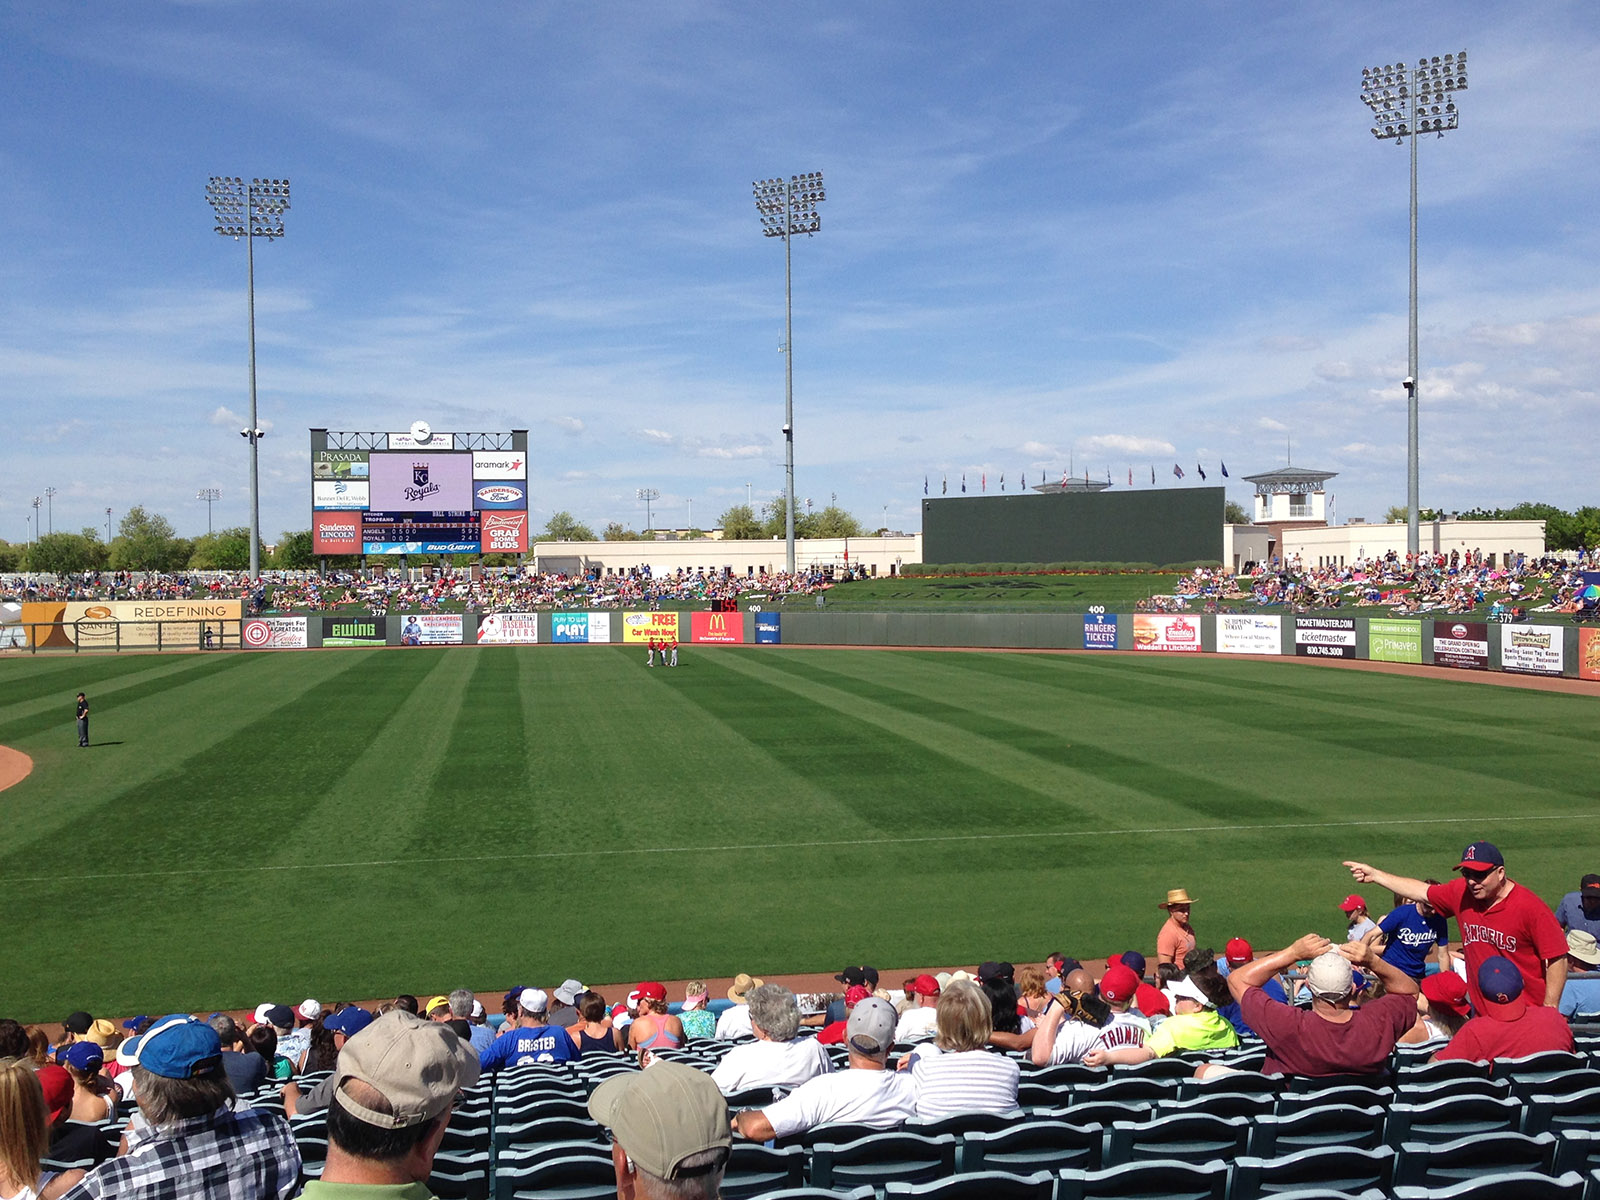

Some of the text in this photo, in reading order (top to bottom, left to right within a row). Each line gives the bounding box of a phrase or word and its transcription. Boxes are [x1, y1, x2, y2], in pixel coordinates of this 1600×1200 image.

[320, 451, 362, 462] PRASADA
[475, 461, 510, 469] aramark
[415, 470, 428, 483] KC
[404, 482, 440, 502] Royals
[480, 488, 520, 497] SANDERSON
[490, 493, 509, 501] Ford
[319, 523, 355, 532] Sanderson
[447, 543, 476, 552] LIGHT
[491, 542, 519, 550] BUDS
[134, 606, 226, 618] REDEFINING
[1088, 606, 1105, 614] 400
[652, 614, 676, 626] FREE
[1096, 615, 1104, 624] T
[1296, 618, 1353, 629] TICKETMASTER.COM
[1499, 613, 1513, 623] 379
[503, 620, 536, 629] BASEBALL
[1084, 624, 1116, 633] RANGERS
[502, 629, 536, 637] TOURS
[556, 624, 587, 637] PLAY
[1086, 632, 1115, 642] TICKETS
[1301, 632, 1348, 643] ticketmaster
[1384, 638, 1417, 651] Primavera
[1464, 845, 1477, 860] A
[1397, 927, 1438, 947] Royals
[1463, 923, 1517, 953] ANGELS
[1099, 1026, 1145, 1050] TRUMBO
[517, 1036, 556, 1053] BRISTER
